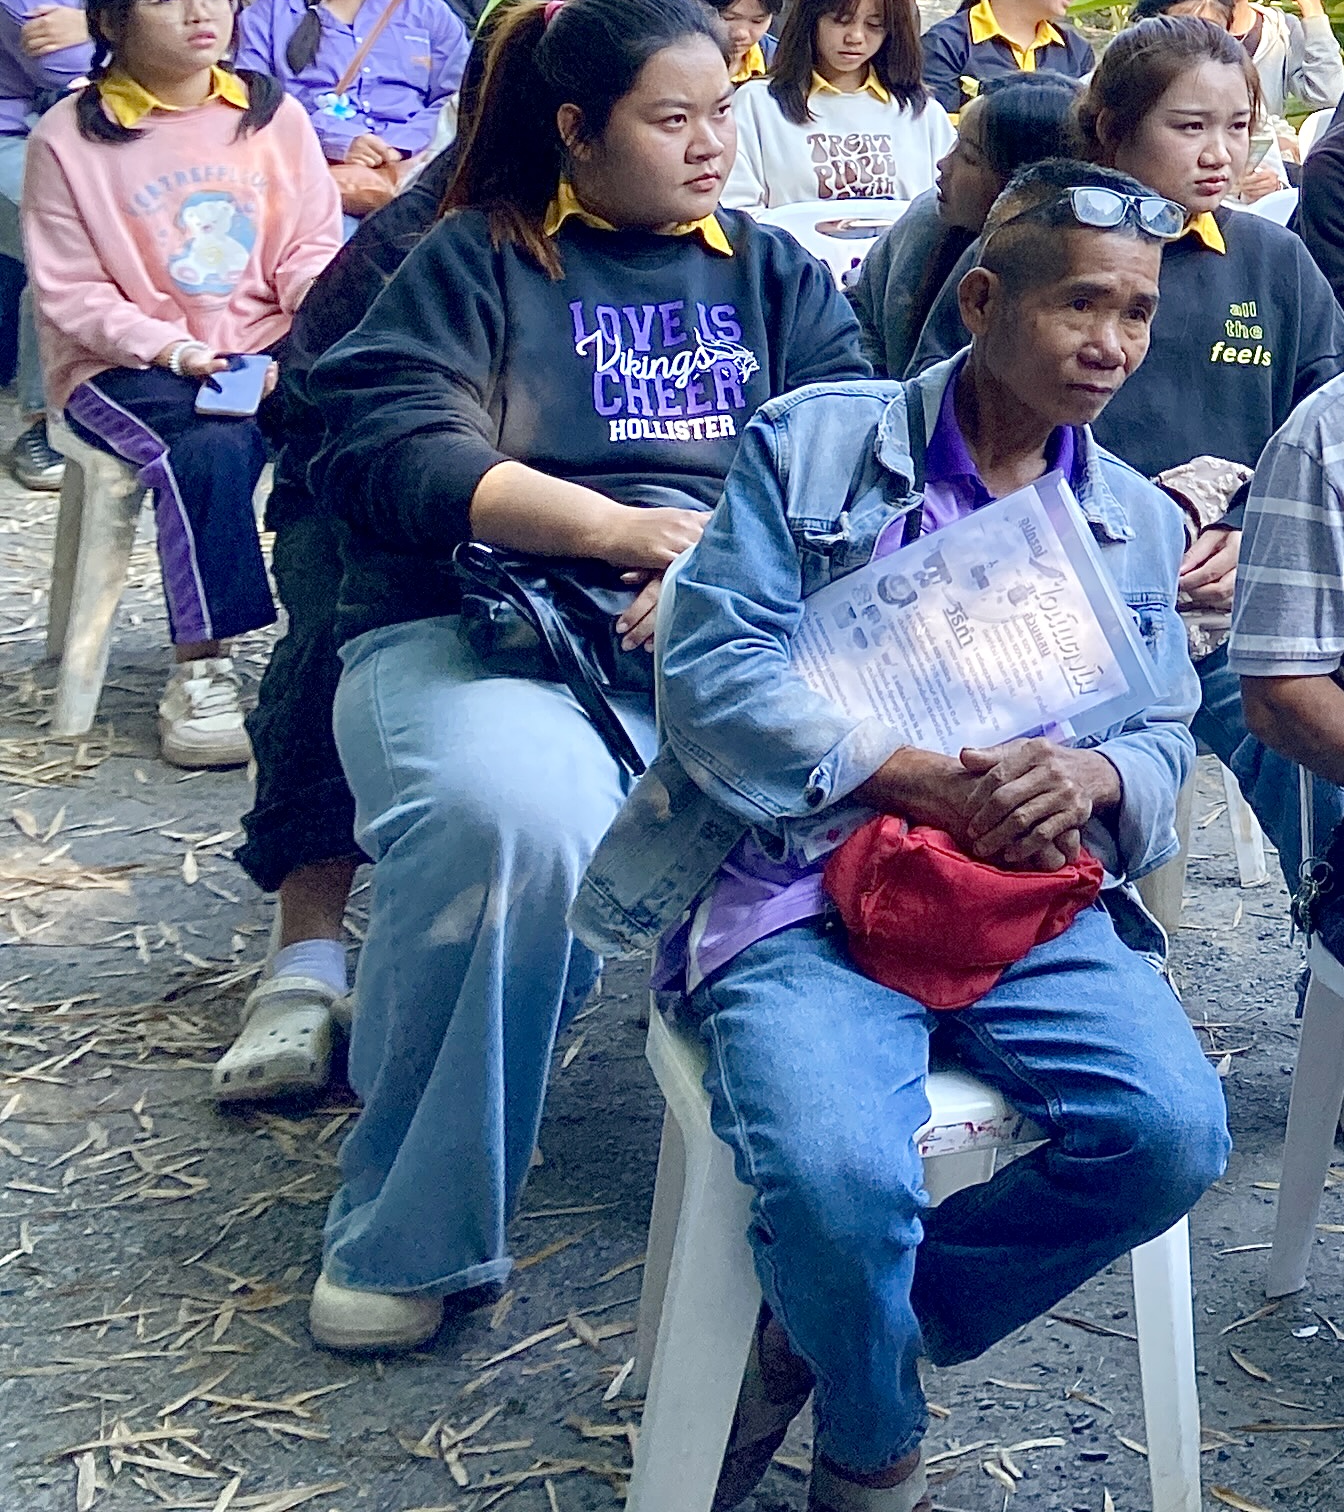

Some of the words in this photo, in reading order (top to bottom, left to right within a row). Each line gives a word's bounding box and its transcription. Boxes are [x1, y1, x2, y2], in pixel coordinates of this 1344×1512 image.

[806, 133, 891, 164] TREAT
[813, 153, 897, 199] PEOPLE
[849, 176, 895, 197] with
[1229, 301, 1258, 318] all
[568, 300, 688, 352] LOVE
[695, 302, 742, 342] IS
[1224, 319, 1263, 340] the
[575, 327, 718, 389] Vikings
[1210, 341, 1273, 367] feels
[593, 359, 747, 417] CHEER
[609, 414, 737, 443] HOLLISTER
